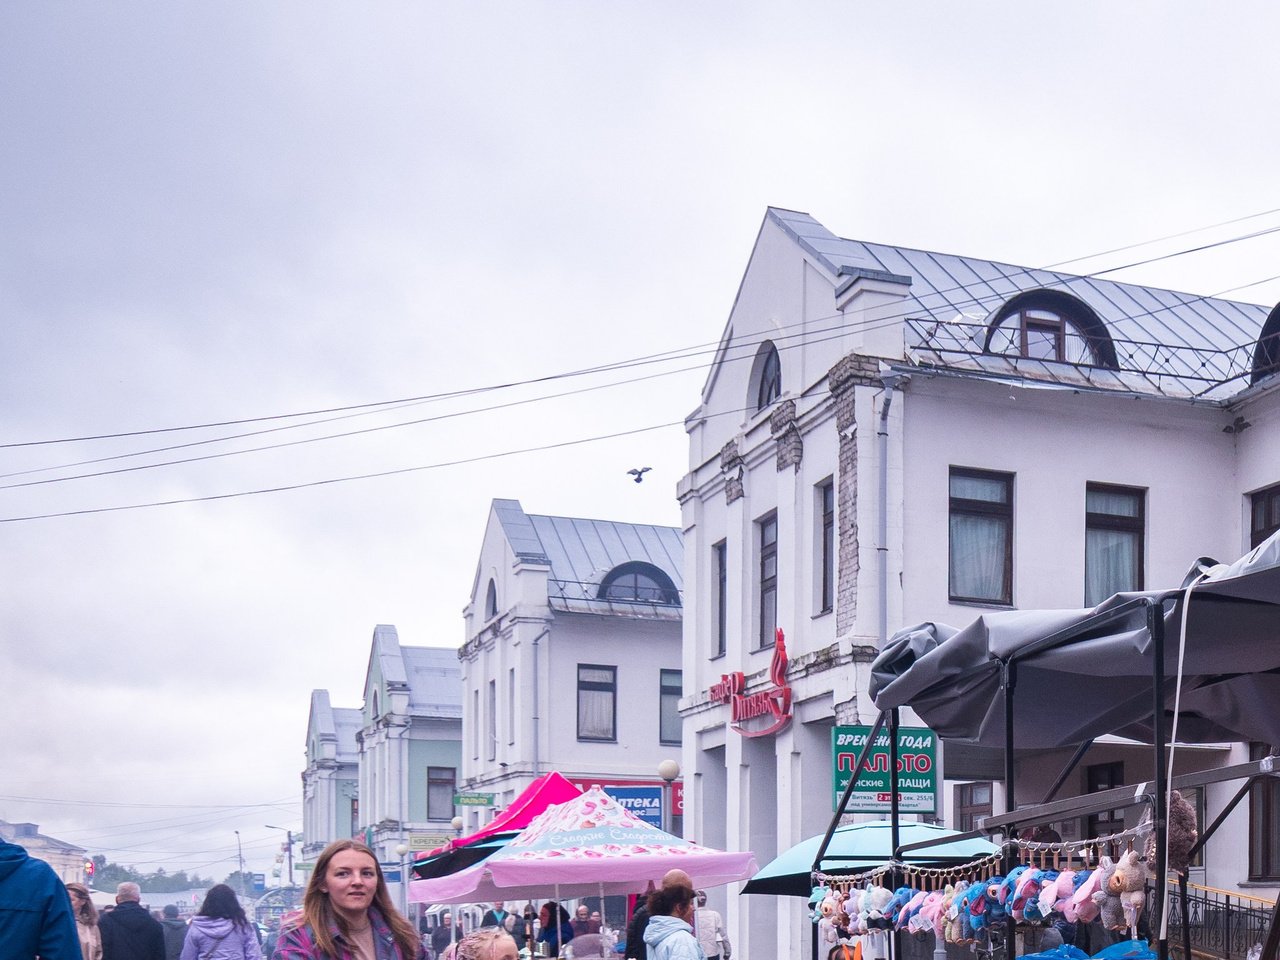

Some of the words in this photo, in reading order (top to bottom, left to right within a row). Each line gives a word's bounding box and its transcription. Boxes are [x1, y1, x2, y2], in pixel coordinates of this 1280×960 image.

[837, 734, 891, 746] ВРЕМН
[840, 779, 884, 787] жнские
[889, 778, 931, 789] ЛАЩИ
[414, 838, 446, 846] КРЕПЕЖ
